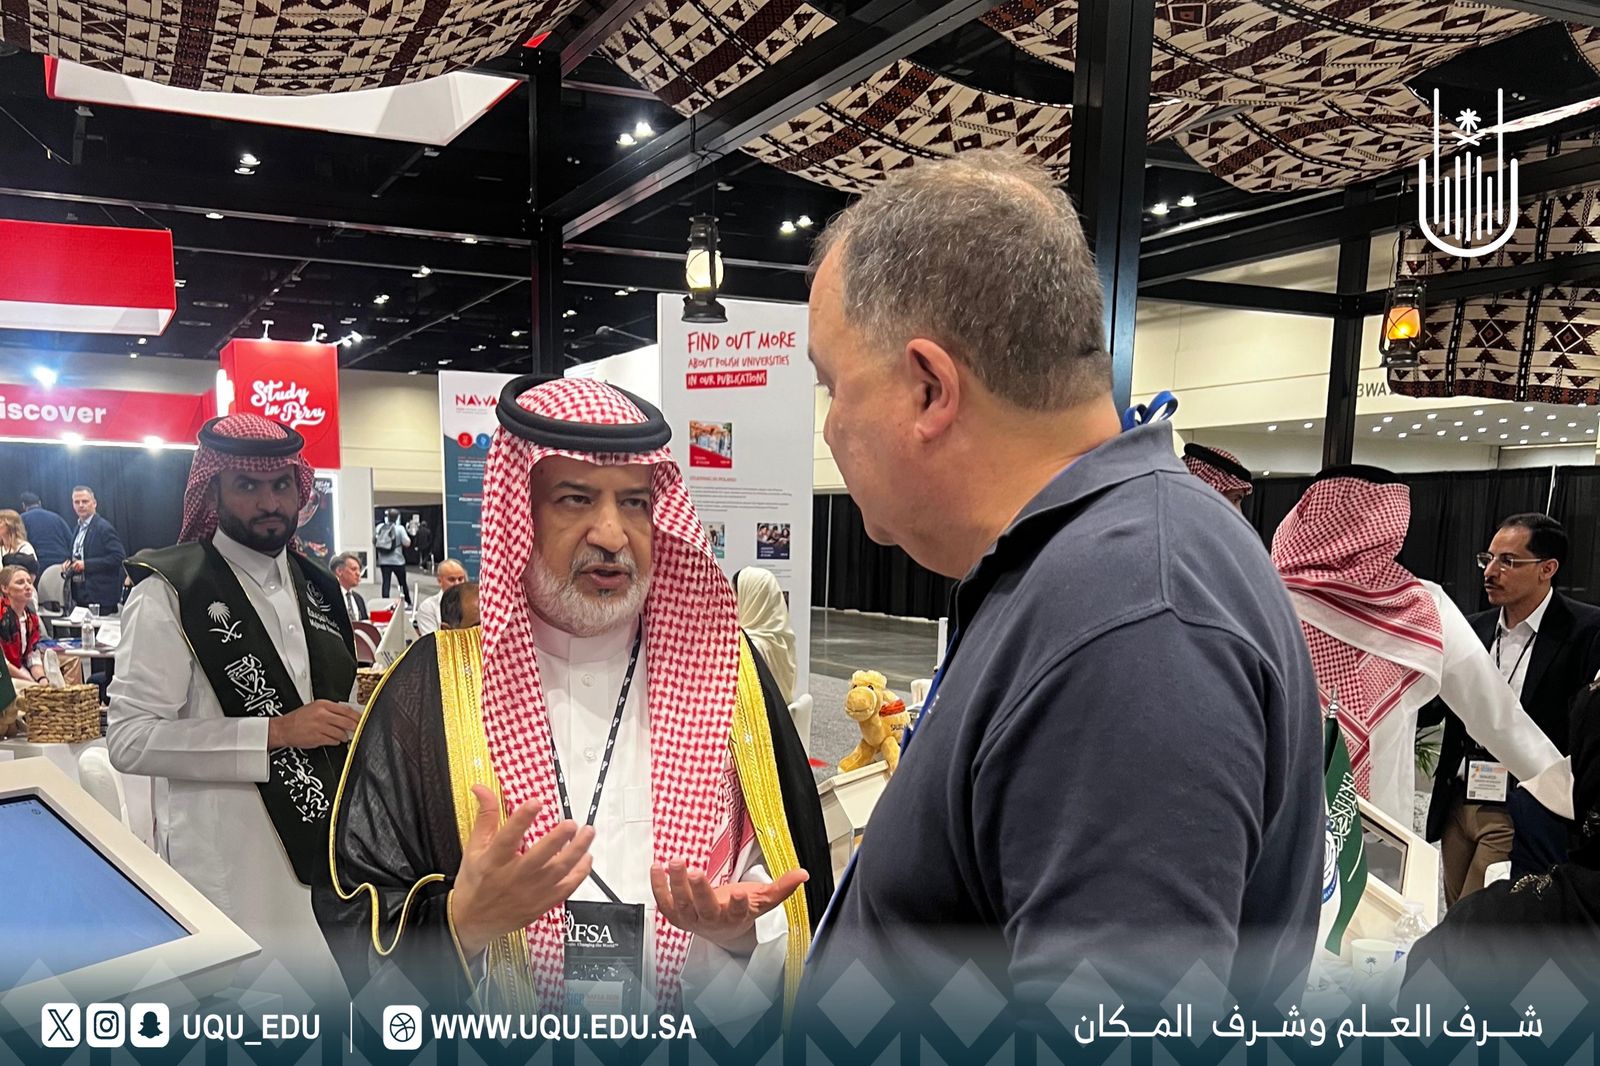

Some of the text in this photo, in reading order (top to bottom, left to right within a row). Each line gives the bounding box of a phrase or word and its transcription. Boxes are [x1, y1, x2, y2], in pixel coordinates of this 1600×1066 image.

[688, 331, 796, 353] FIND OUT MORE
[688, 355, 789, 369] ABOUT POLISH UNIVERSITIES
[688, 372, 766, 386] IN OUR PUBLICATIONS
[250, 379, 309, 407] Study
[455, 394, 497, 407] NAWA
[0, 396, 107, 424] iscover
[264, 402, 326, 430] in Peru
